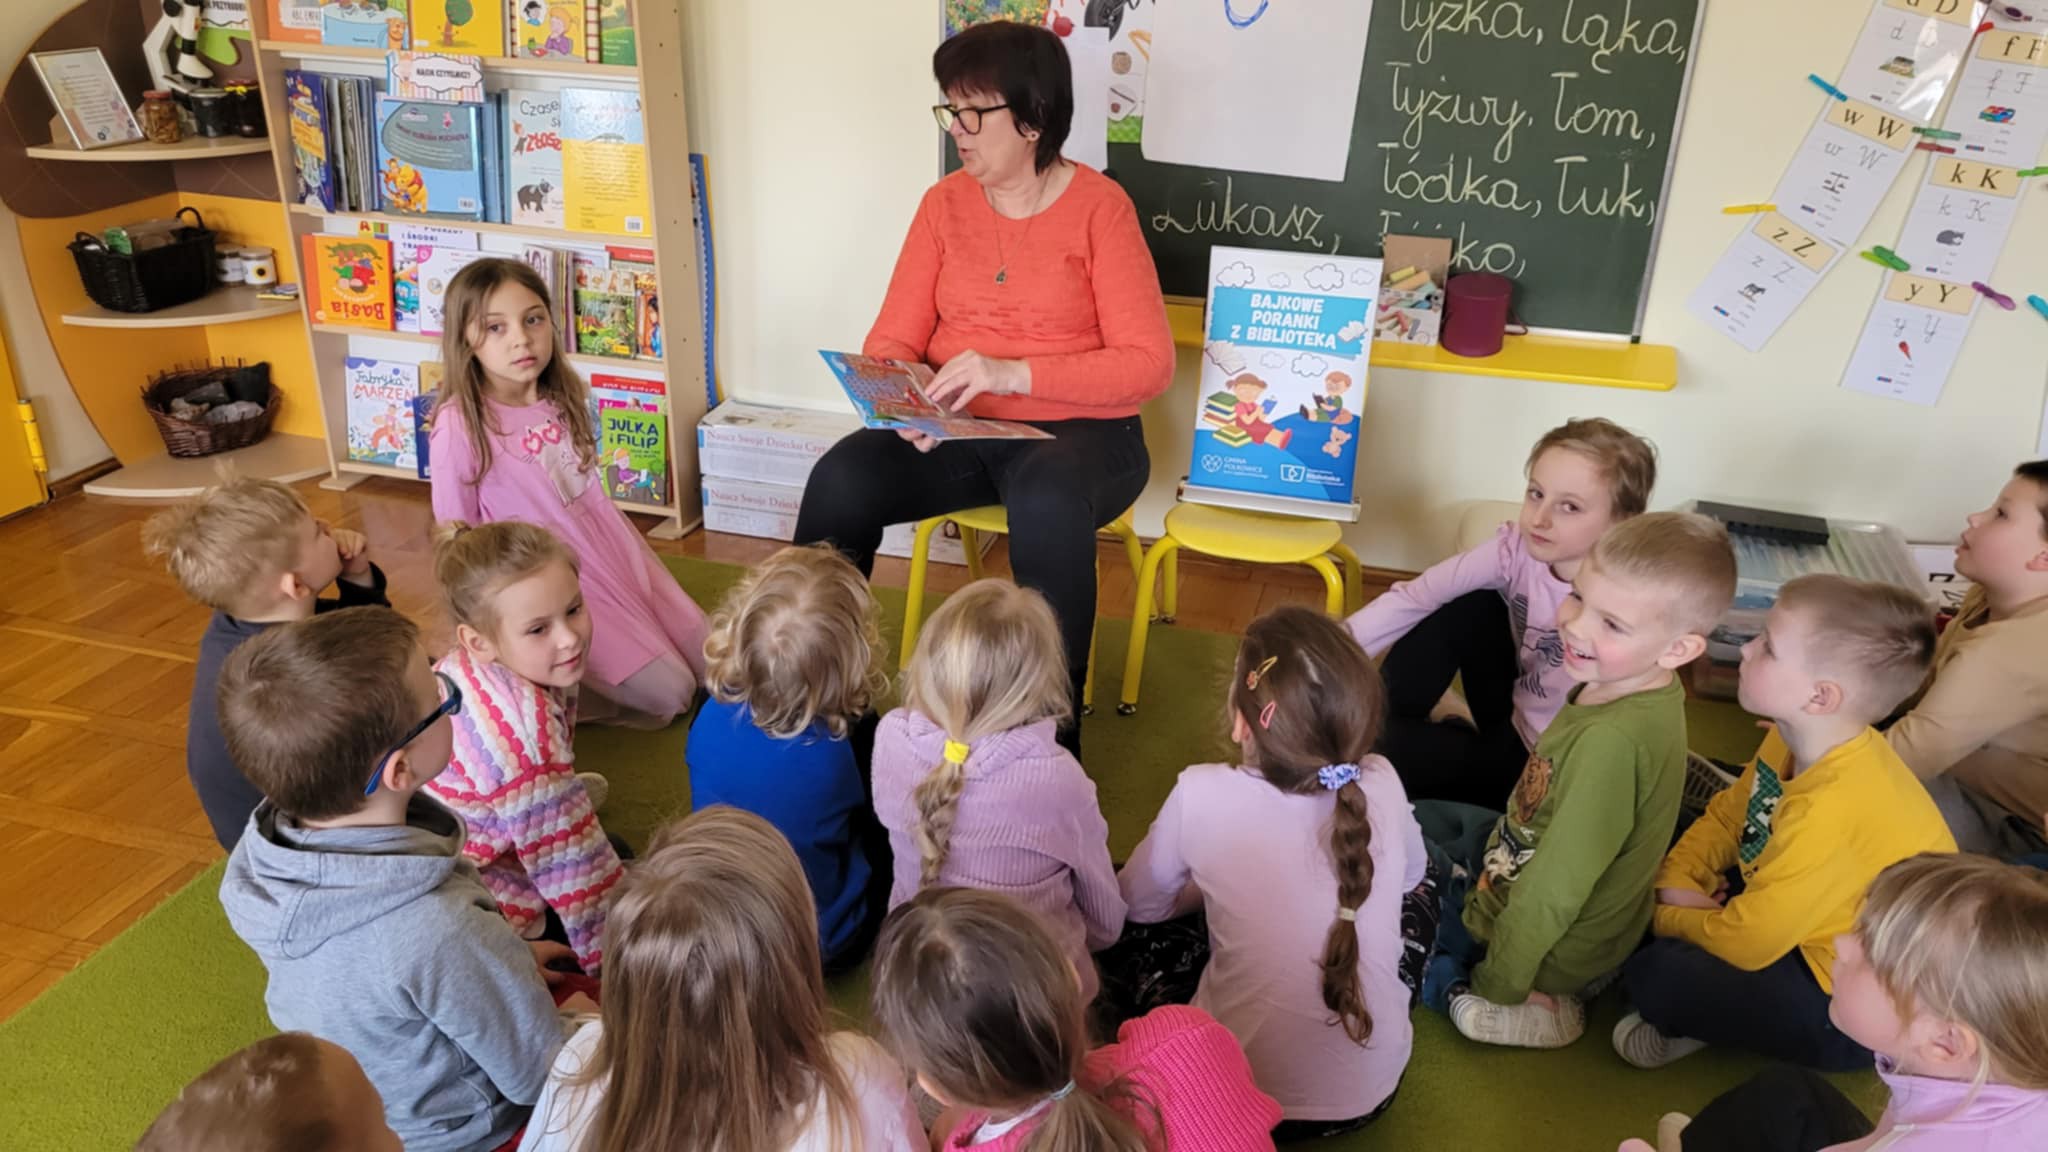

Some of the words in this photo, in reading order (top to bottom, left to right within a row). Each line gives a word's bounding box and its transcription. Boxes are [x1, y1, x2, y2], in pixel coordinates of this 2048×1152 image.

[2003, 34, 2021, 57] f
[1844, 108, 1865, 126] w
[1877, 115, 1905, 139] W
[1950, 162, 1967, 184] k
[1979, 168, 2003, 190] K
[1375, 209, 1527, 280] Łko,
[1772, 226, 1789, 243] z
[1792, 236, 1817, 259] Z
[1250, 293, 1325, 314] BAJKOWE
[1904, 283, 1924, 302] y
[1939, 283, 1958, 304] Y
[330, 301, 385, 321] Basia
[1251, 309, 1320, 330] PORANKI
[1230, 324, 1241, 339] Z
[355, 370, 404, 387] Fabryka
[607, 418, 659, 436] JULKA
[617, 433, 659, 449] FILIP
[738, 433, 764, 447] Swoje
[766, 437, 803, 450] Dziecko
